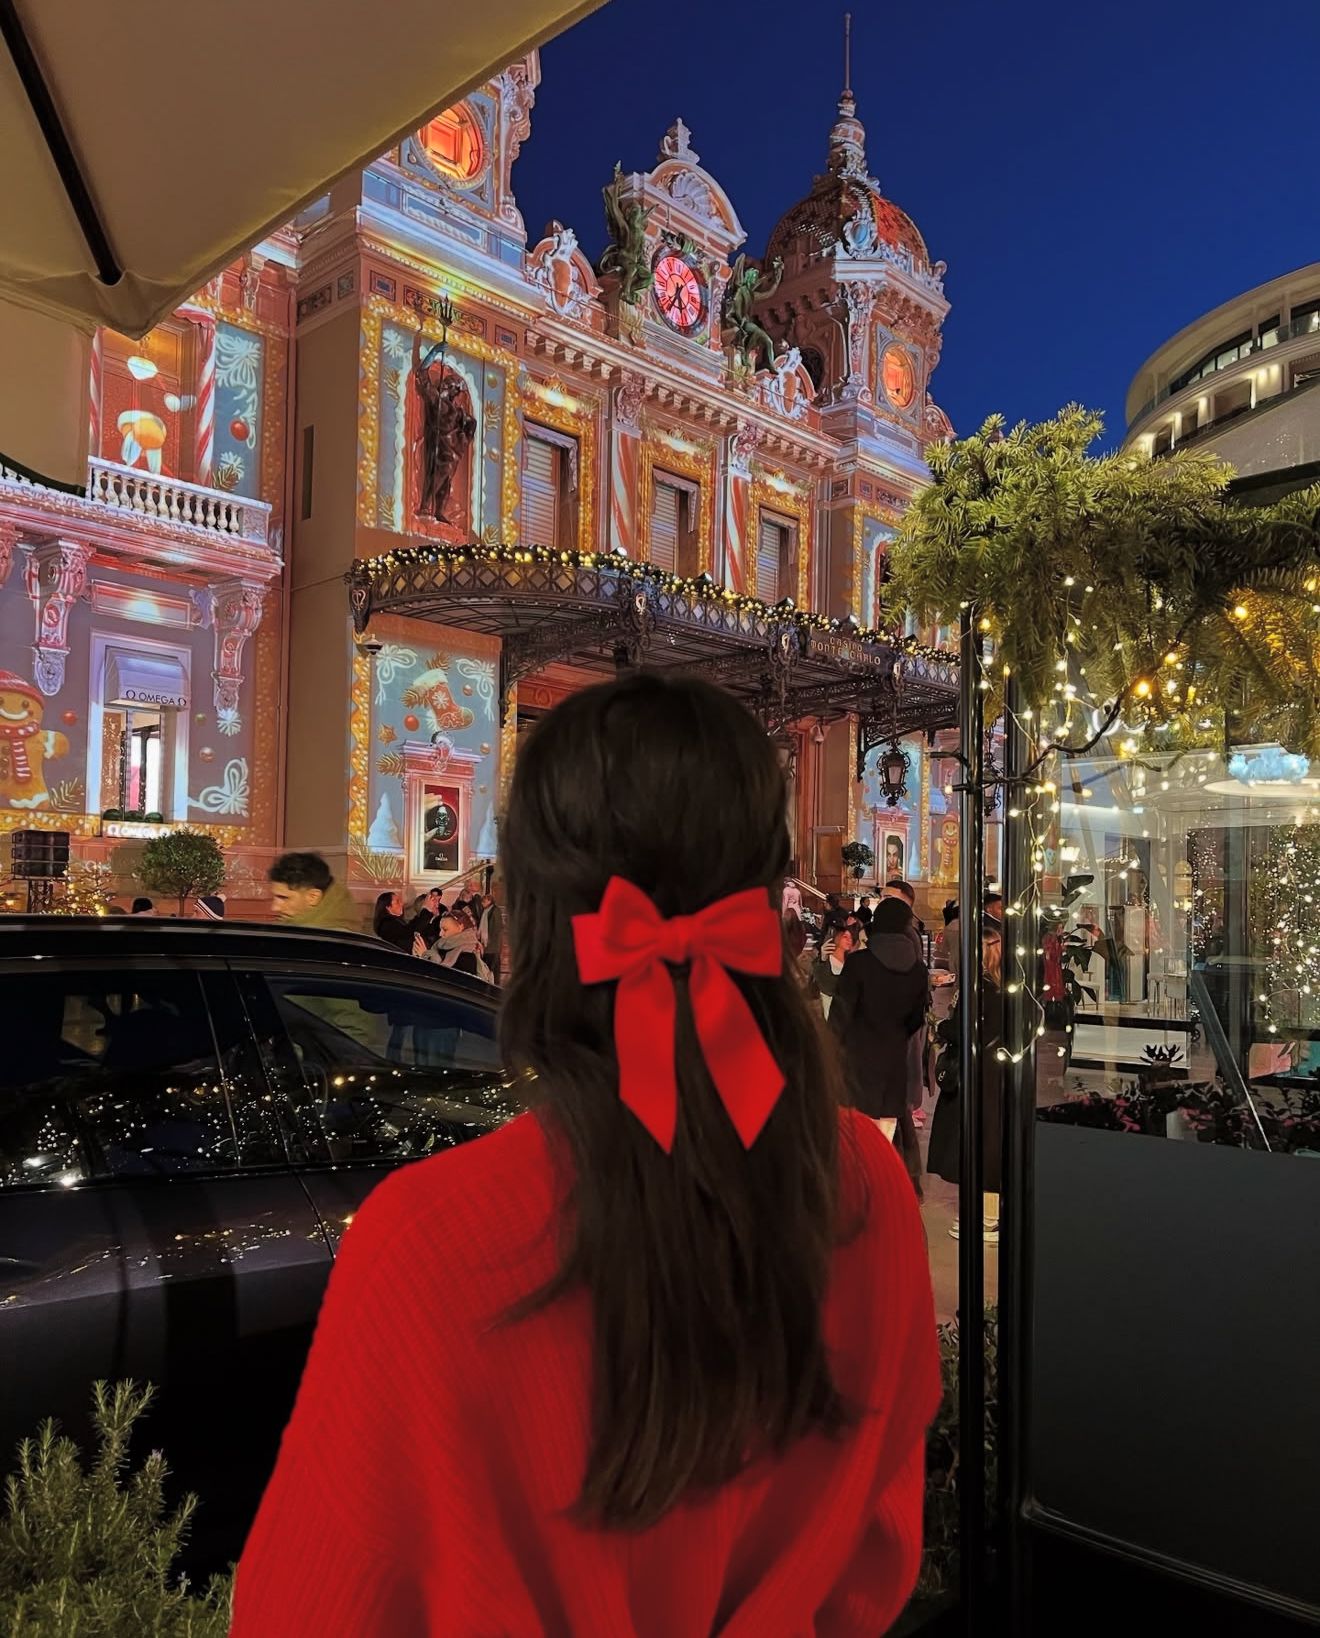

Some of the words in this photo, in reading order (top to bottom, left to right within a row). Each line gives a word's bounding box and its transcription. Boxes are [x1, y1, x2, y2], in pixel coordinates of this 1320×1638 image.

[810, 639, 843, 656] MONTE
[849, 650, 881, 665] CARLO
[829, 636, 863, 652] CASINO
[138, 692, 175, 705] OMEGA
